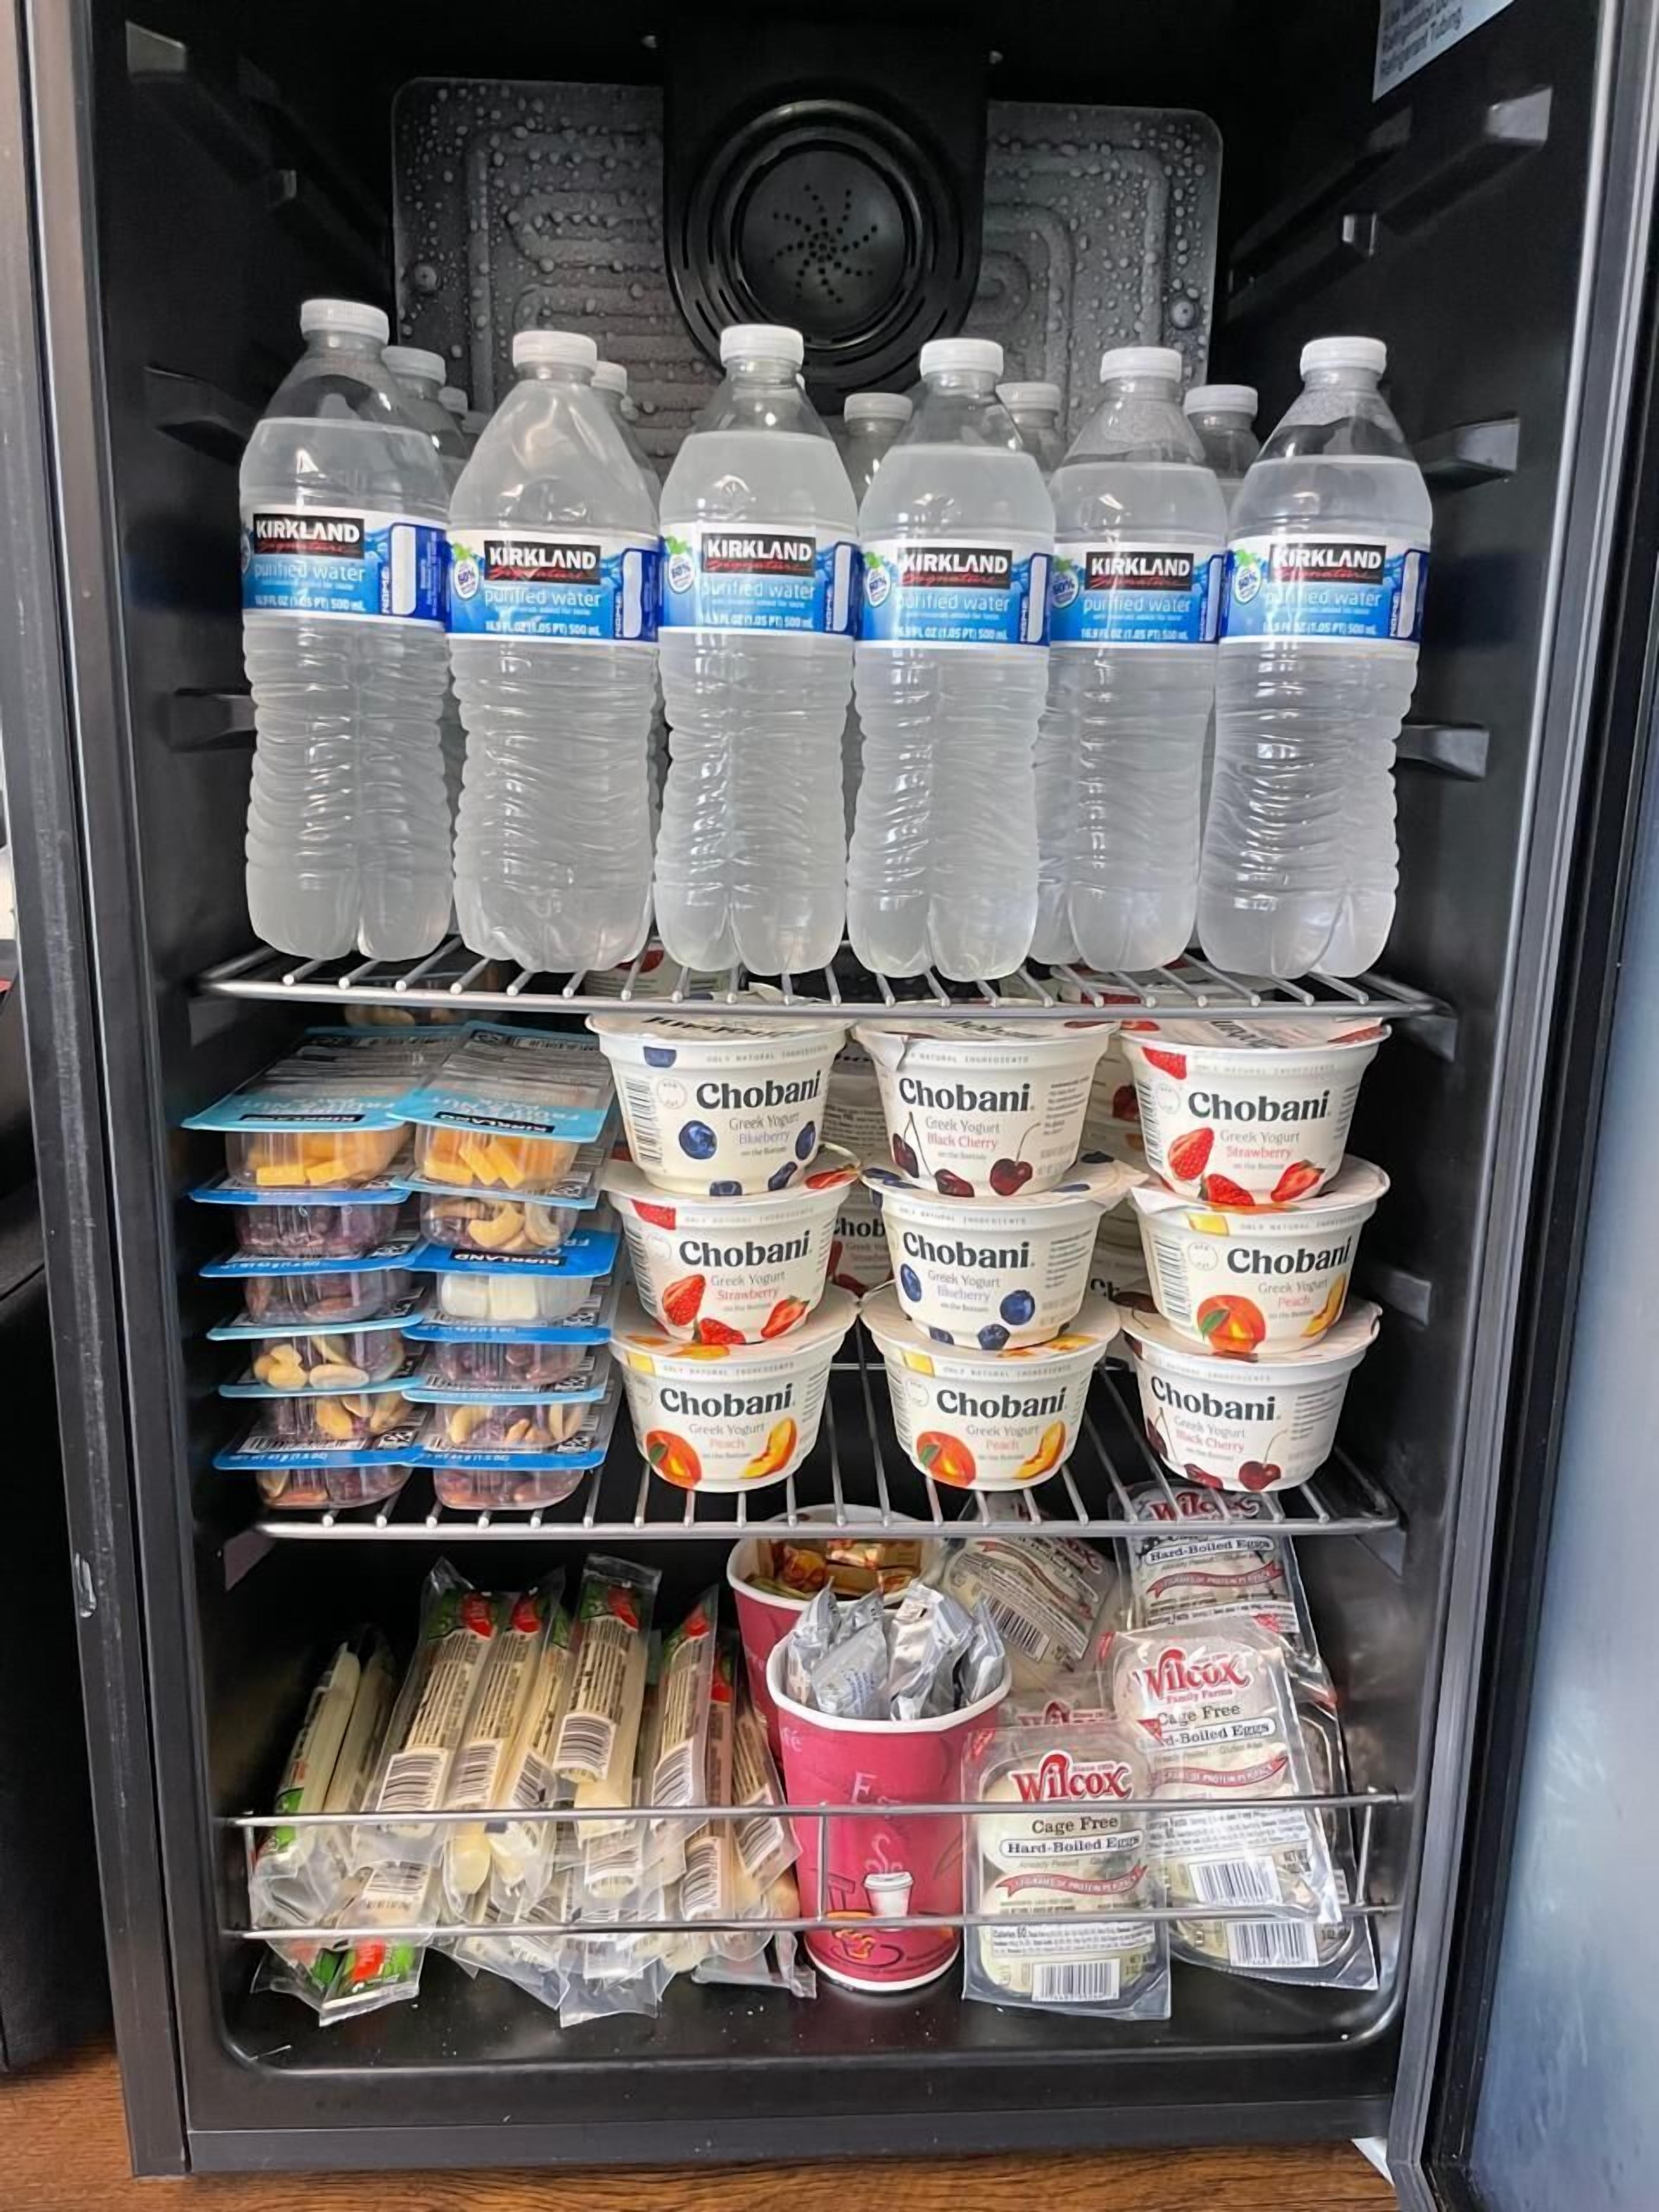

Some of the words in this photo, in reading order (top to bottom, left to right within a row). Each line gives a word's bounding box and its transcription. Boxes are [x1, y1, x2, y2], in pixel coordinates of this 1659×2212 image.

[256, 519, 360, 543] KIRKLAND
[490, 547, 596, 569] KIRKLAND
[708, 540, 812, 561] KIRKLAND
[1272, 549, 1381, 569] KIRKLAND
[254, 561, 306, 579] purified
[313, 563, 365, 582] water
[903, 553, 1008, 573] KIRKLAND
[1092, 558, 1190, 576] KIRKLAND
[484, 588, 546, 606] purified
[553, 592, 601, 607] water
[770, 582, 814, 599] water
[1336, 592, 1381, 607] water
[964, 595, 1009, 612] water
[1150, 597, 1190, 612] water
[696, 1069, 821, 1109] Chobani
[899, 1078, 1030, 1112] Chobani
[1189, 1090, 1330, 1122] Chobani
[729, 1115, 763, 1130] Greek
[926, 1116, 957, 1131] Greek
[960, 1119, 1000, 1135] Yogurt
[740, 1131, 790, 1144] Blueberry
[928, 1131, 956, 1146] Black
[959, 1135, 996, 1151] Cherry
[1220, 1129, 1256, 1142] Greek
[1259, 1131, 1300, 1144] Yogurt
[1226, 1146, 1291, 1159] Strawberry
[680, 1230, 810, 1267] Chobani
[903, 1232, 1030, 1268] Chobani
[1227, 1235, 1352, 1274] Chobani
[455, 1253, 560, 1265] KIRKLAND
[711, 1275, 744, 1286] Greek
[749, 1271, 785, 1285] Yogurt
[928, 1270, 957, 1284] Greek
[961, 1274, 1000, 1289] Yogurt
[1258, 1282, 1292, 1294] Greek
[717, 1288, 777, 1300] Strawberry
[937, 1285, 990, 1303] Blueberry
[660, 1383, 793, 1417] Chobani
[937, 1386, 1067, 1418] Chobani
[1151, 1375, 1275, 1421] Chobani
[689, 1424, 724, 1434] Greek
[726, 1424, 764, 1435] Yogurt
[966, 1424, 1001, 1437] Greek
[1003, 1425, 1038, 1437] Yogurt
[1173, 1415, 1204, 1433] Greek
[1208, 1423, 1245, 1438] Yogurt
[1176, 1429, 1203, 1445] Black
[1205, 1437, 1244, 1454] Cherry
[1150, 1541, 1233, 1561] Hard-Boiled
[1132, 1648, 1251, 1701] Wilcox
[1158, 1710, 1196, 1727] Cage
[1202, 1705, 1241, 1719] Free
[1161, 1729, 1227, 1746] d-Boiled
[1011, 1754, 1132, 1804] Wilcox
[1032, 1819, 1074, 1835] Cage
[1081, 1816, 1119, 1831] Free
[1008, 1838, 1101, 1853] Hard-Boiled
[1107, 1836, 1139, 1849] Eggs
